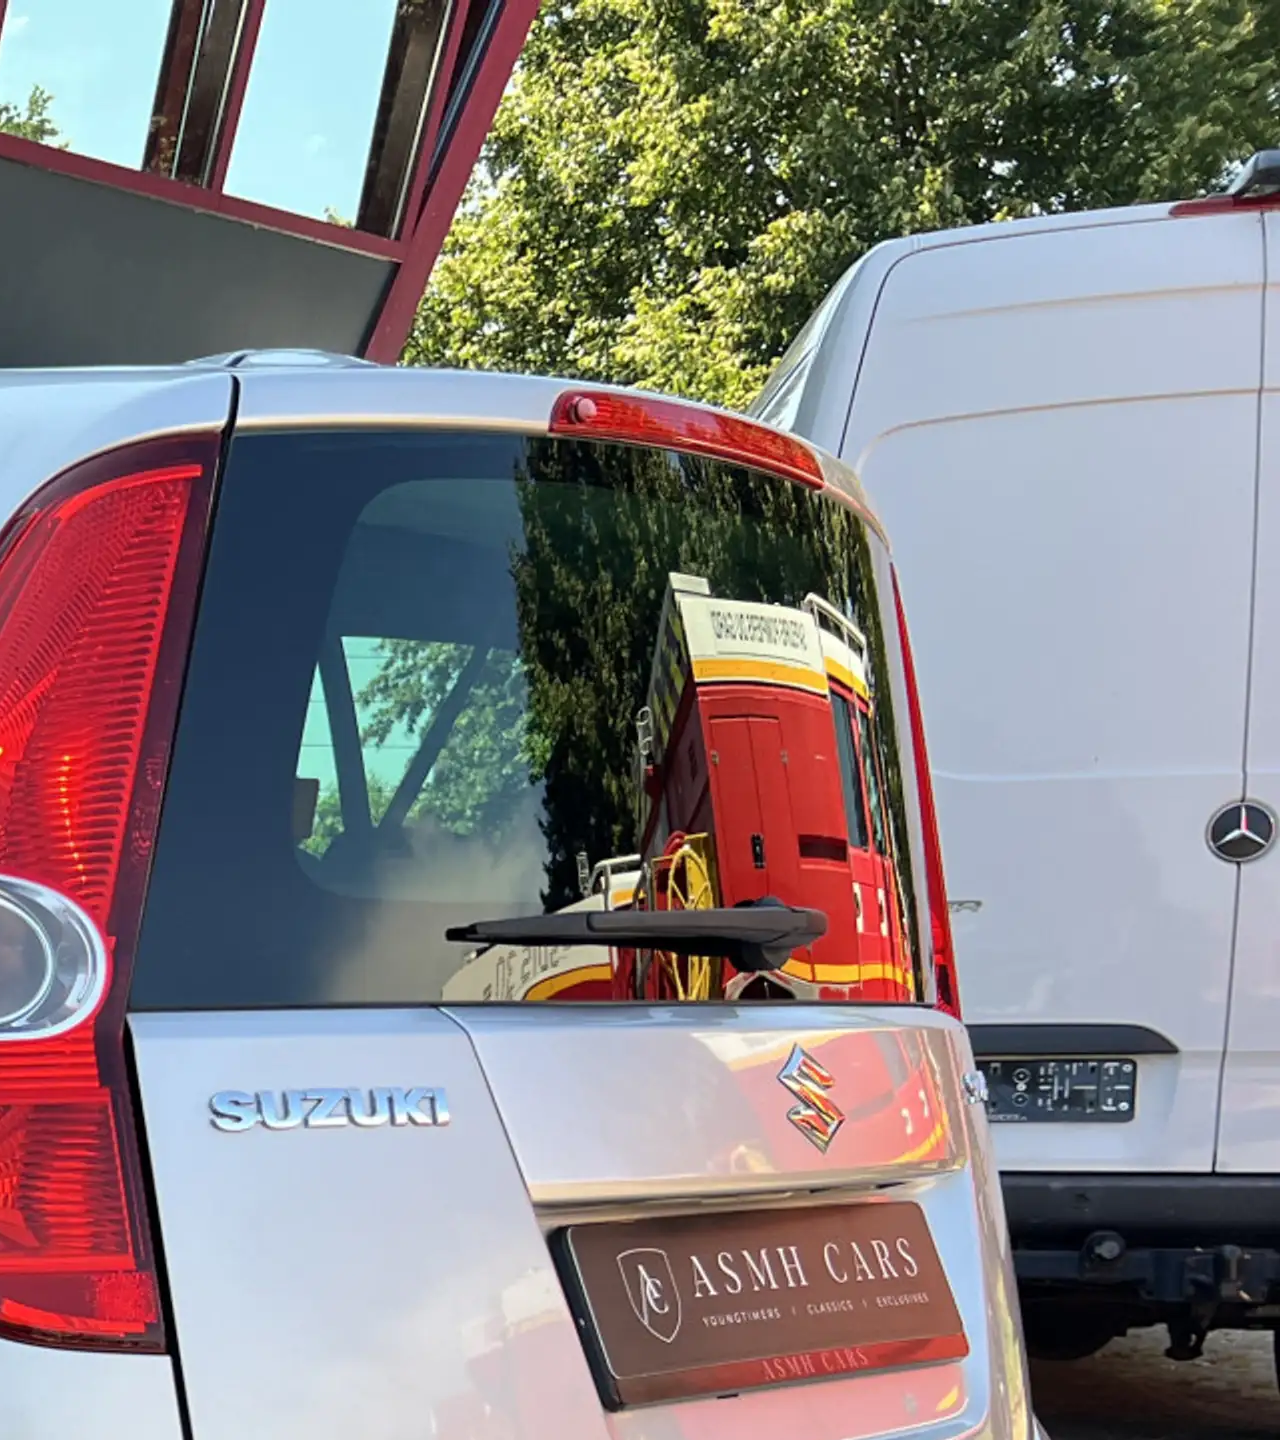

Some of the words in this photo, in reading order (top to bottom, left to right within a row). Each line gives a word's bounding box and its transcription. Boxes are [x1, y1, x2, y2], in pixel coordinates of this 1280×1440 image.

[208, 1086, 451, 1133] SUZUKI
[689, 1245, 809, 1298] ASMH
[823, 1237, 919, 1284] CARS
[702, 1307, 782, 1328] YOUNGTIMERS
[806, 1299, 855, 1316] CLASSICS
[876, 1291, 930, 1309] EXCLUSIVES
[763, 1355, 816, 1381] ASMH
[821, 1347, 869, 1373] CARS
